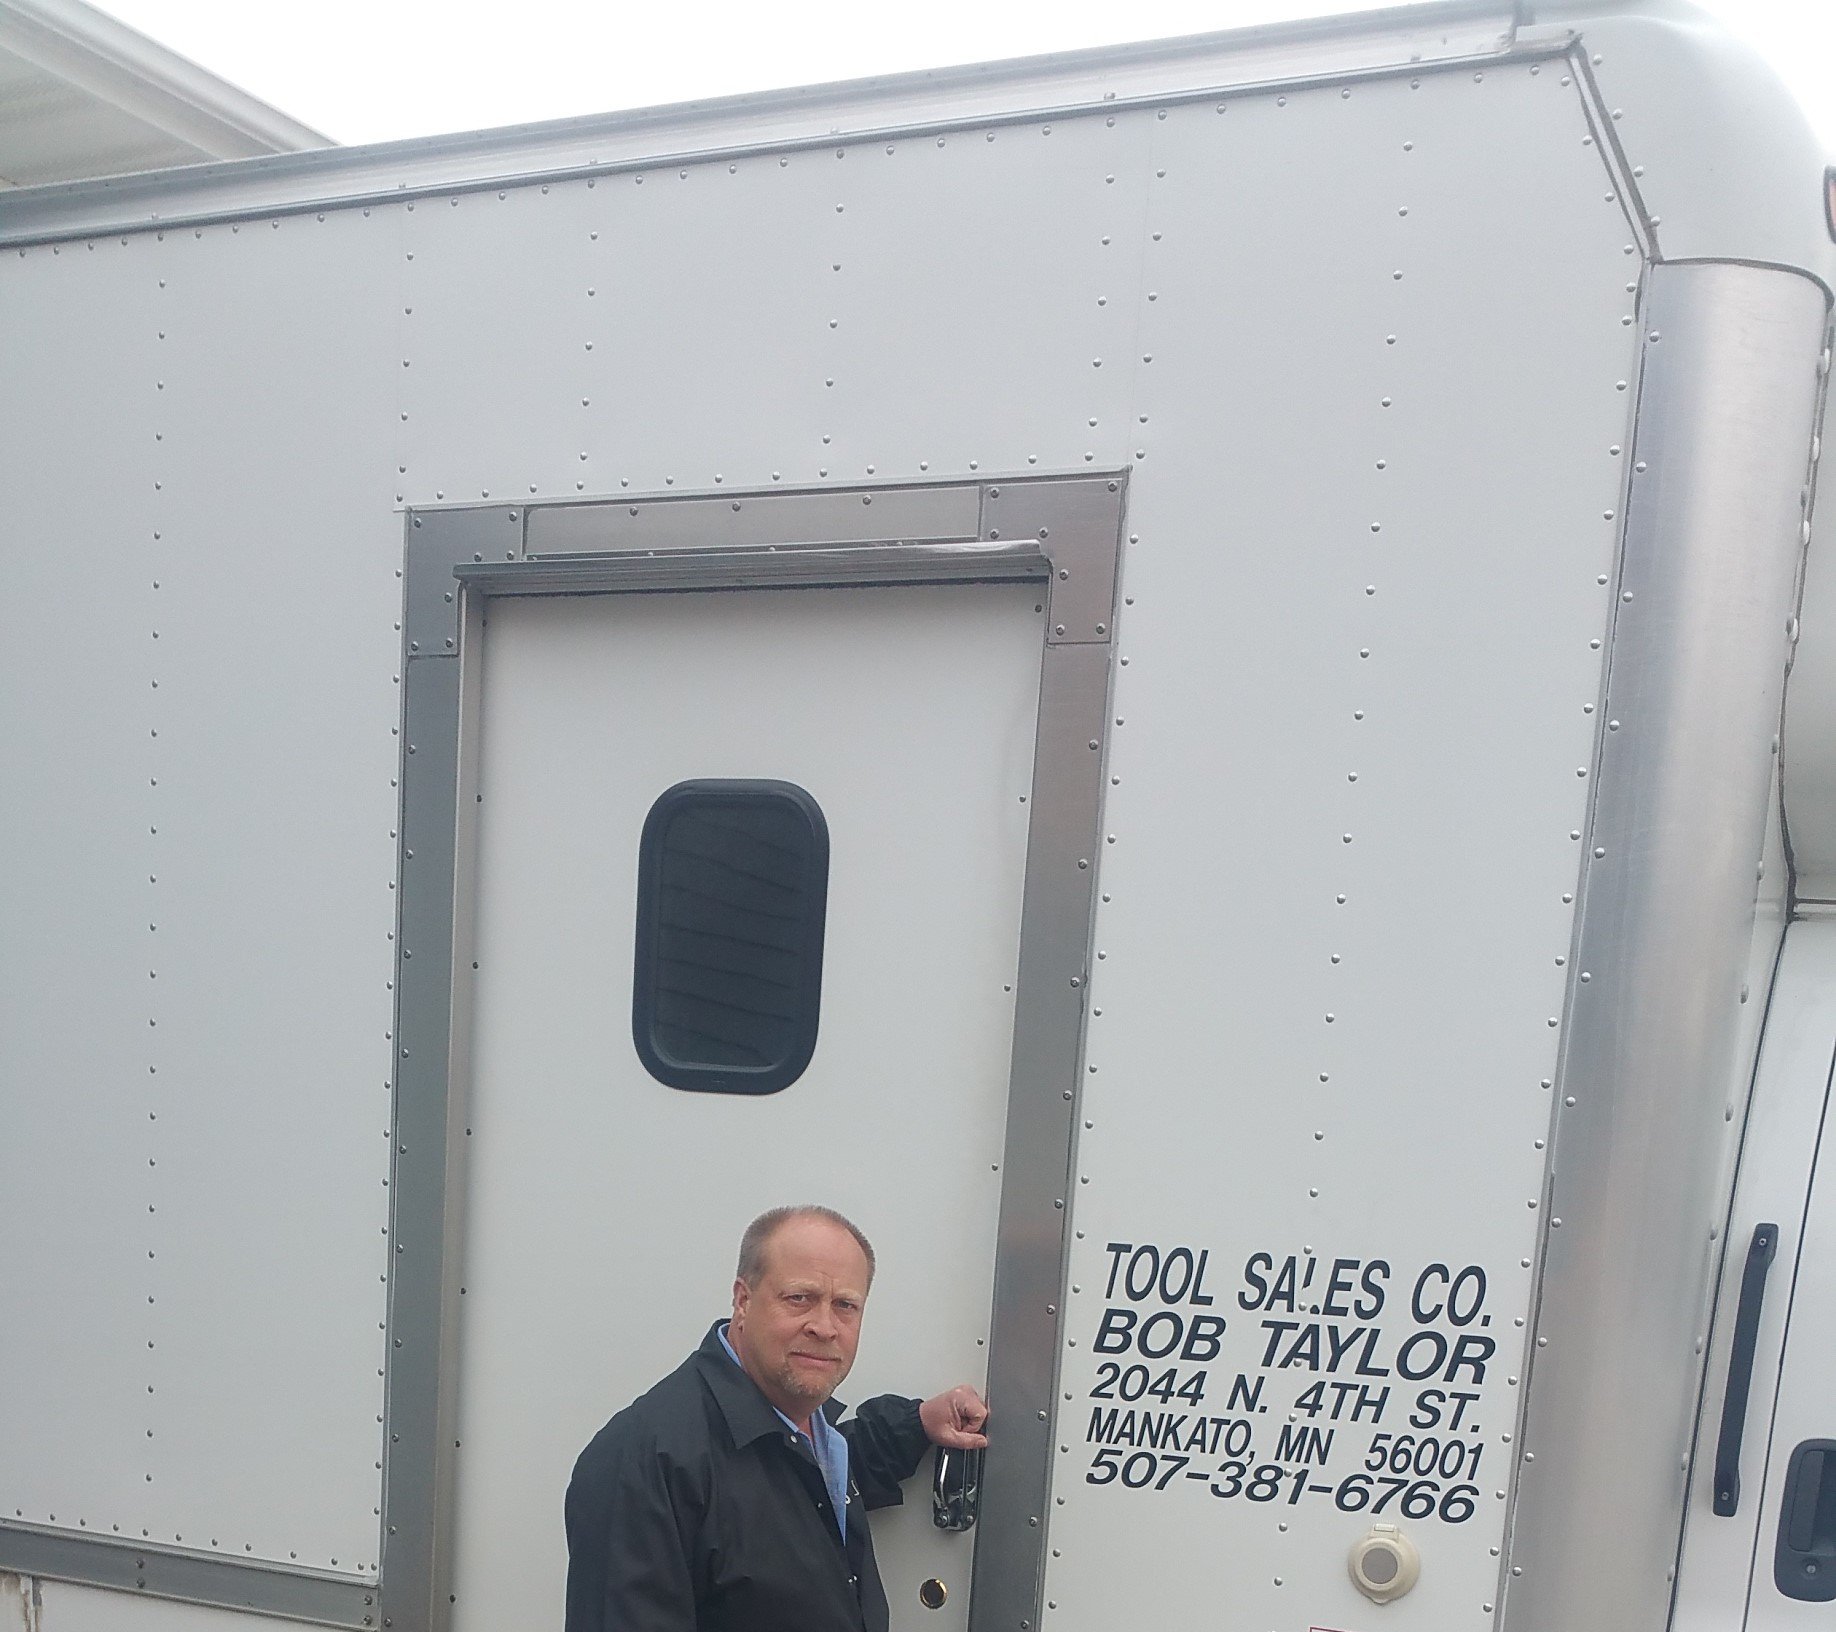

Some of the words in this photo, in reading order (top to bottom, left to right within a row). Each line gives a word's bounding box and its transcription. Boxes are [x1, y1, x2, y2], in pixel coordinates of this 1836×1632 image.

[1106, 1243, 1213, 1306] TOOL
[1412, 1263, 1491, 1327] CO.
[1093, 1309, 1226, 1361] BOB
[1261, 1320, 1495, 1384] TAYLOR
[1089, 1363, 1207, 1406] 2044
[1227, 1374, 1267, 1413] N.
[1294, 1381, 1390, 1423] 4TH
[1410, 1389, 1480, 1432] ST.
[1086, 1407, 1255, 1466] MANKATO,
[1274, 1425, 1334, 1465] MN
[1365, 1433, 1483, 1480] 56001
[1086, 1449, 1479, 1523] 507-381-6766
